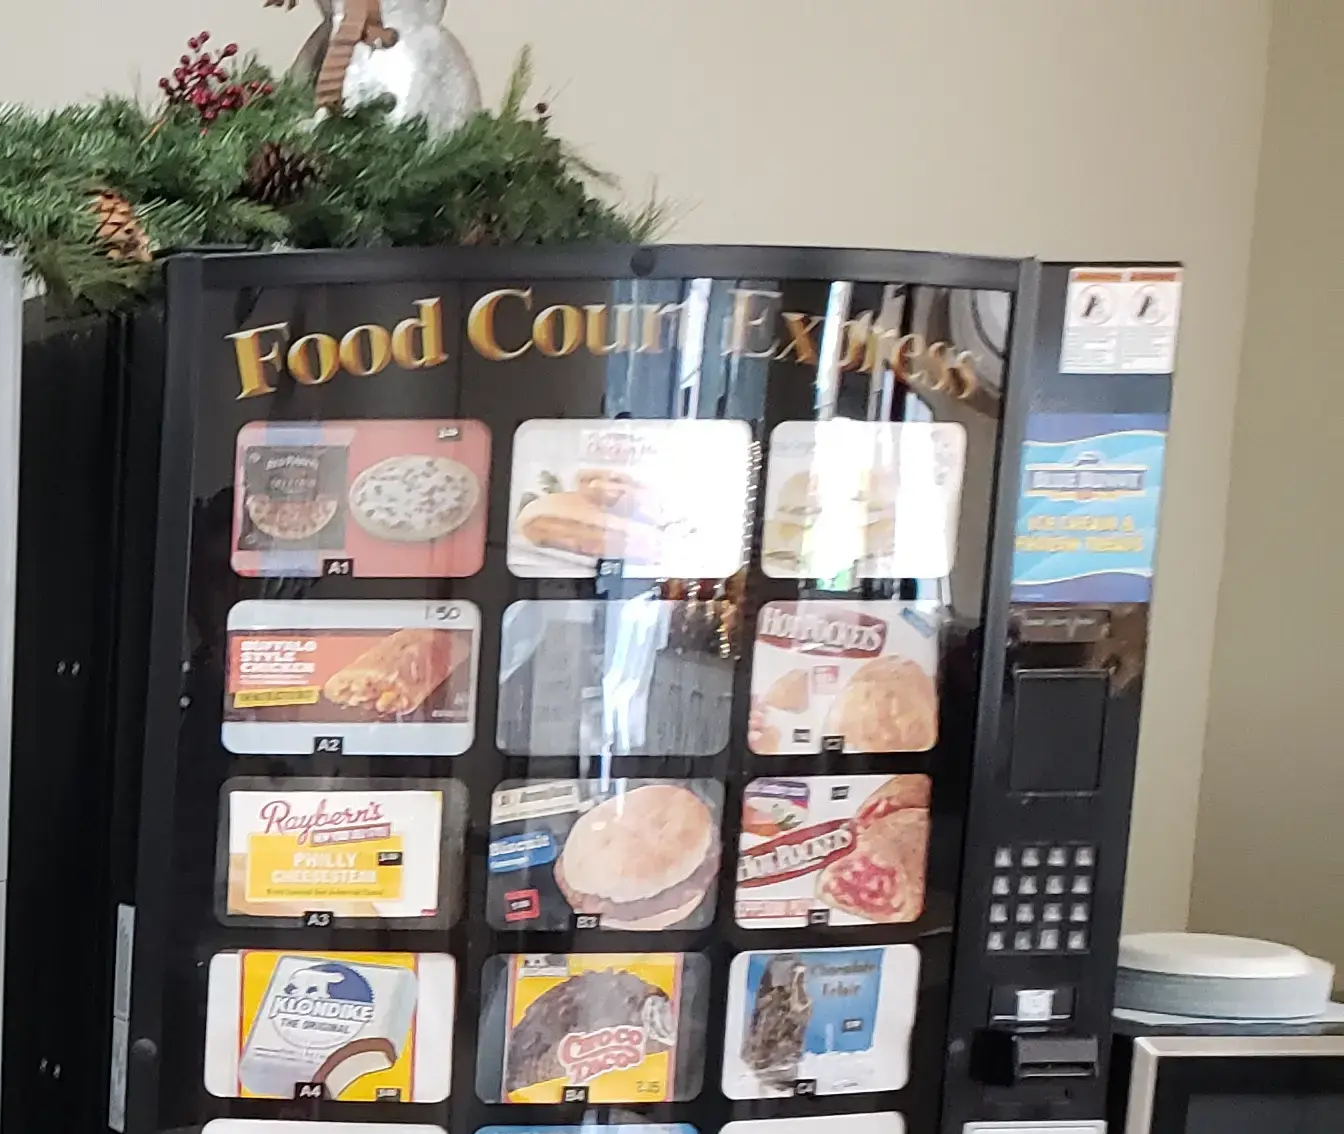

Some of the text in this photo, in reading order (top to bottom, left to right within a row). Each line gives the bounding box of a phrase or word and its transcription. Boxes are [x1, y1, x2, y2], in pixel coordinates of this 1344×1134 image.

[224, 296, 449, 400] Food
[467, 287, 706, 362] Cour
[327, 561, 349, 575] A1
[316, 738, 341, 752] A2
[259, 798, 386, 846] Raybern's
[291, 852, 357, 869] PHILLY
[306, 912, 331, 927] A3
[269, 994, 376, 1023] KLONDIKE
[280, 1017, 299, 1029] THE
[300, 1085, 322, 1097] A4
